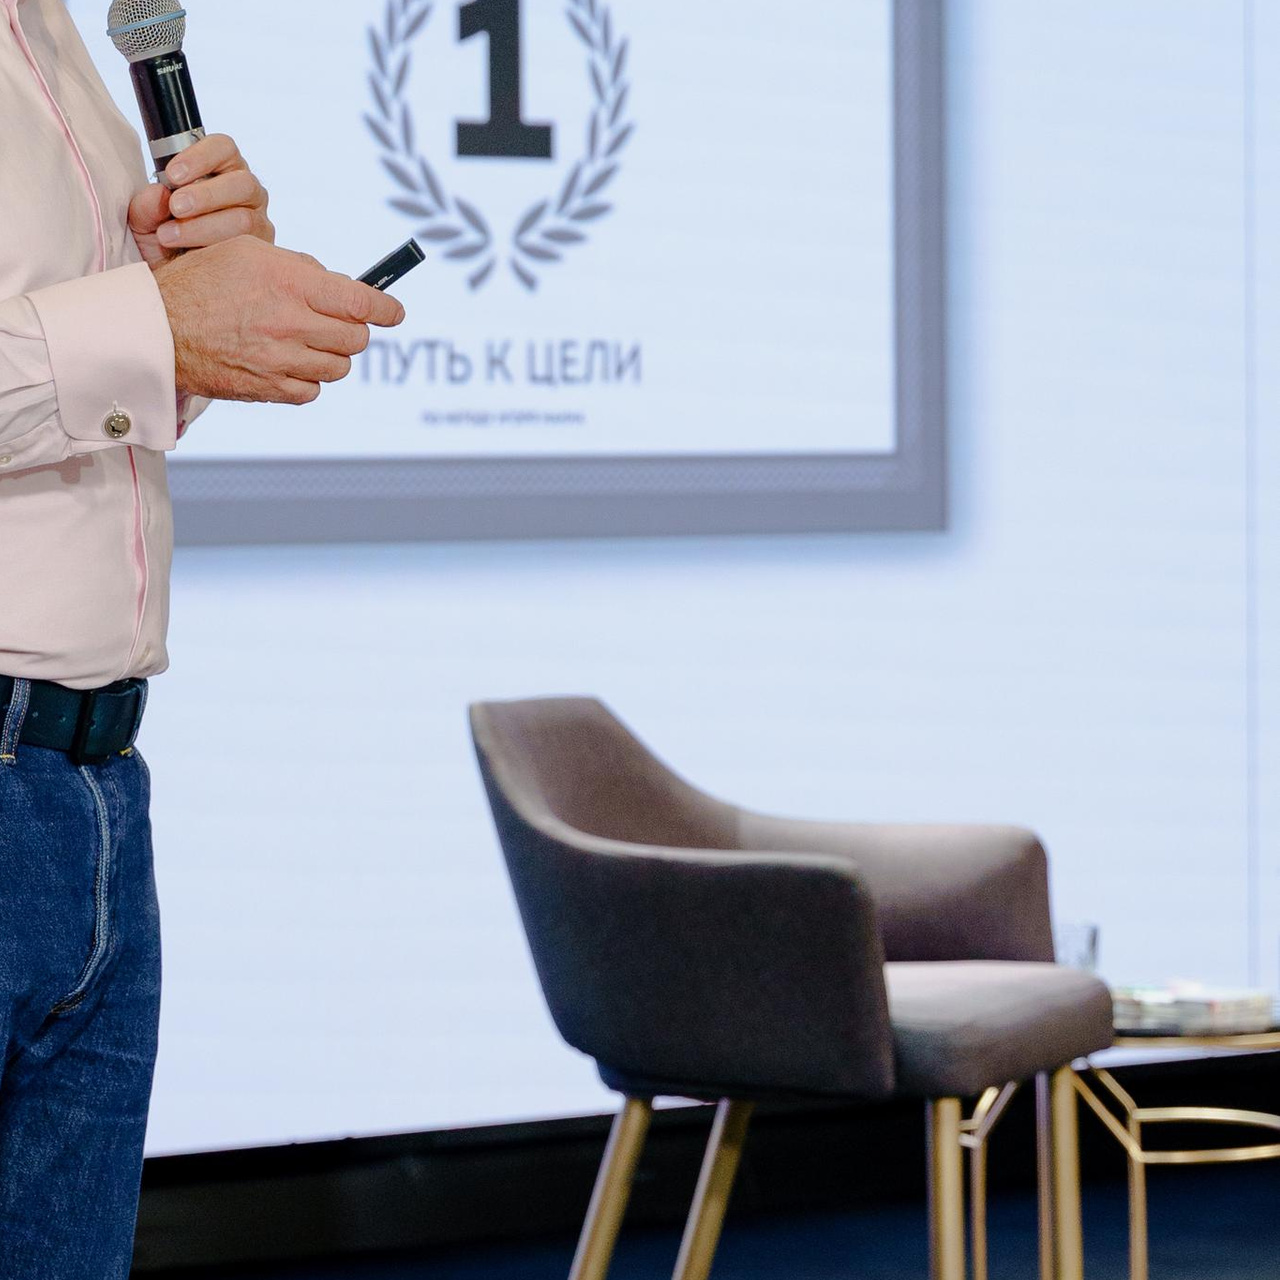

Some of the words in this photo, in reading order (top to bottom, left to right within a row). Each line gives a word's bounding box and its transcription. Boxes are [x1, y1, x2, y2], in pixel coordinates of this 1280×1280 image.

[156, 62, 183, 76] SHURE
[361, 337, 474, 385] ПУТЬ
[484, 339, 514, 383] К
[527, 340, 643, 388] ЦЕЛИ
